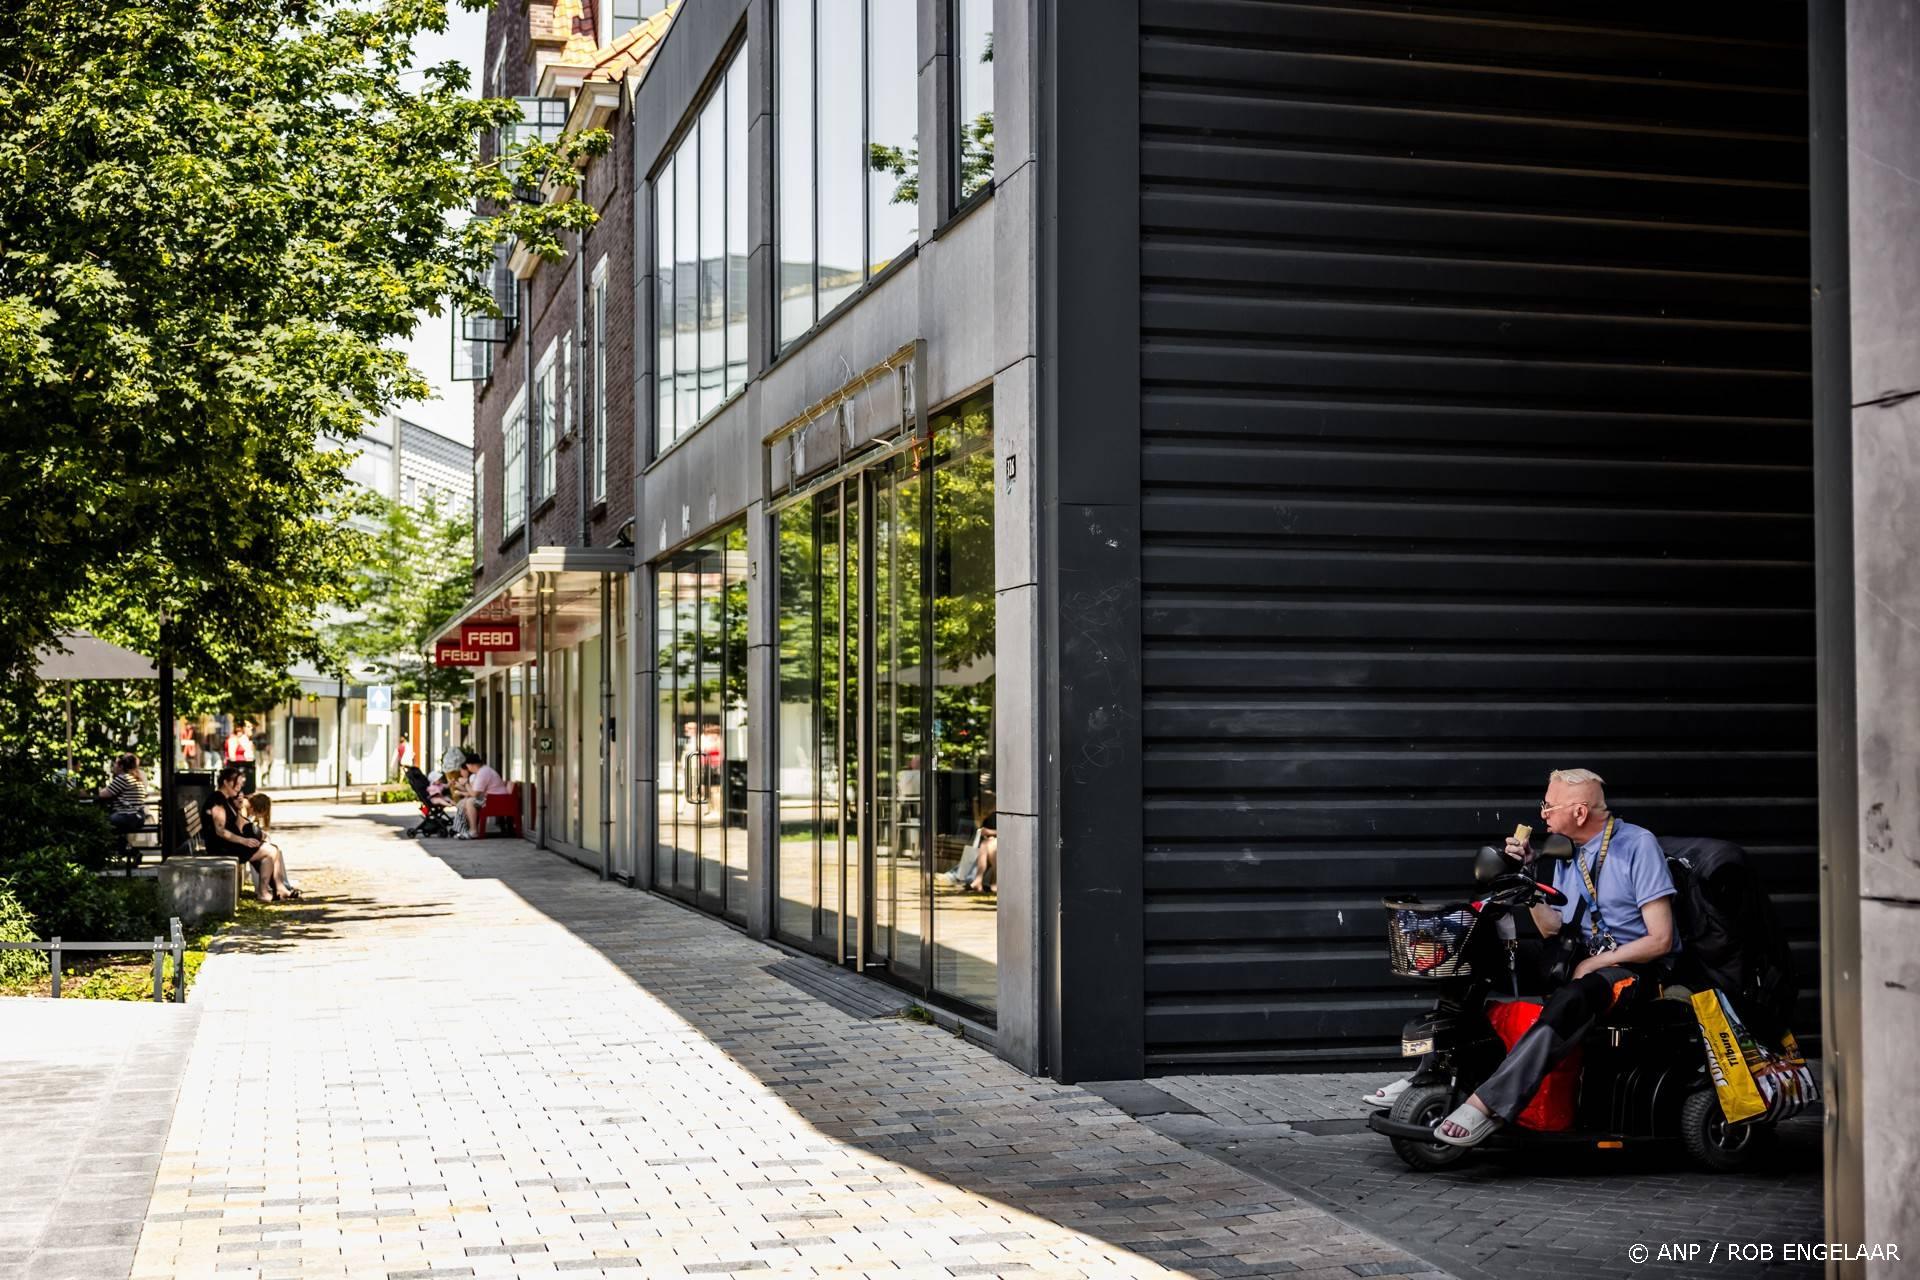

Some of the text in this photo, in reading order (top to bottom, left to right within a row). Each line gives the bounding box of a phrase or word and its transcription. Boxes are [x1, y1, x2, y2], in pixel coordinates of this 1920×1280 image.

[468, 632, 513, 645] FEBO
[441, 650, 480, 661] FEBO
[1697, 1022, 1730, 1087] JUM
[1719, 1031, 1739, 1067] Tilburg
